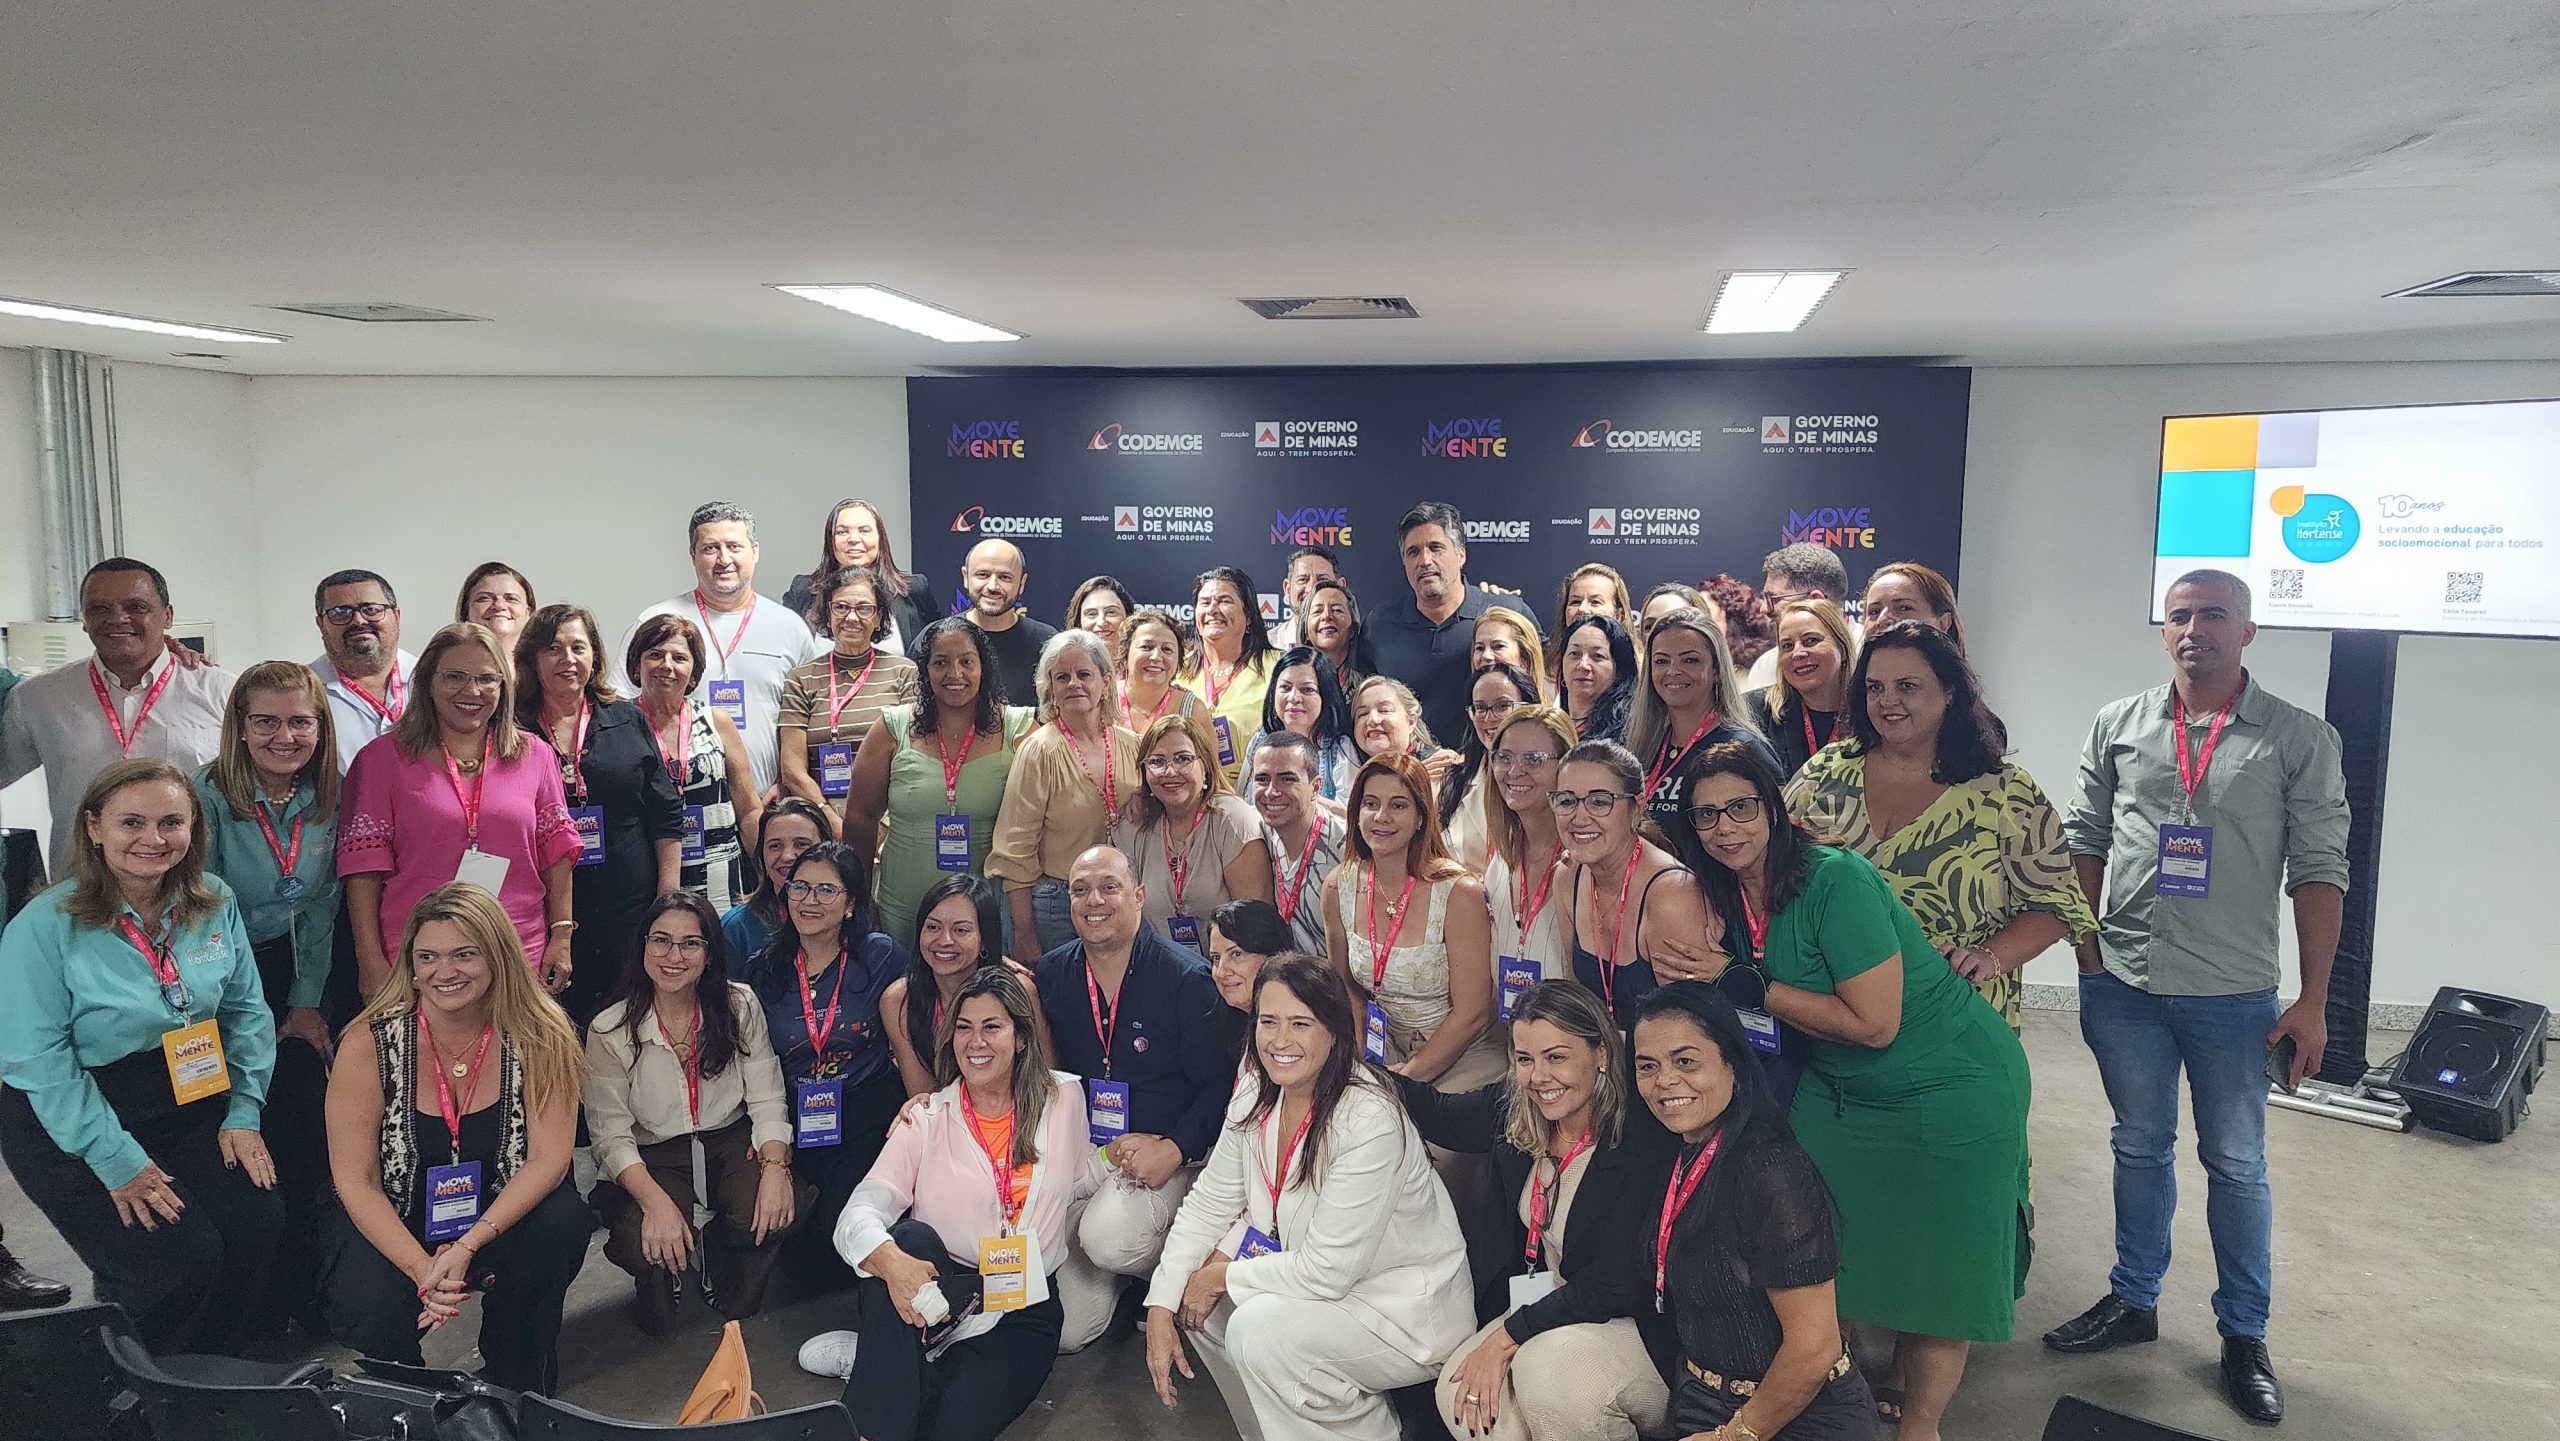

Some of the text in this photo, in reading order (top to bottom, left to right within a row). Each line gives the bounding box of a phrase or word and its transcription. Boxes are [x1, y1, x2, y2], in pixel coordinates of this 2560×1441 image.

[1284, 421, 1358, 433] GOVERNO
[1795, 415, 1879, 428] GOVERNO
[952, 420, 1020, 444] MOVE
[1428, 418, 1502, 444] MOVE
[1795, 430, 1878, 443] DE MINAS
[1118, 434, 1202, 450] CODEMGE
[1284, 435, 1358, 448] DE MINAS
[1606, 430, 1701, 448] CODEMGE
[947, 438, 1025, 459] MENTE
[1421, 436, 1507, 458] MENTE
[1142, 506, 1214, 518] GOVERNO
[2378, 495, 2445, 518] 10 anos
[1276, 507, 1348, 530] MOVE
[1620, 508, 1700, 521] GOVERNO
[1788, 507, 1871, 532] MOVE
[980, 516, 1062, 533] CODEMGE
[1143, 520, 1214, 532] DE MINAS
[1462, 521, 1530, 538] DEMGE
[1620, 523, 1700, 536] DE MINAS
[2379, 525, 2429, 534] Levando
[2443, 525, 2503, 536] educação
[1270, 524, 1352, 546] MENTE
[1781, 525, 1875, 549] MENTE
[2296, 528, 2343, 539] Hortense
[2378, 538, 2544, 549] socioemocional para todos
[825, 752, 847, 761] MOVE
[940, 829, 967, 838] MENTE
[942, 823, 965, 833] MOVE
[2168, 836, 2204, 847] MOVE
[2165, 843, 2205, 855] MENTE
[1506, 969, 1534, 979] MOVE
[175, 1033, 212, 1054] MOVE
[174, 1041, 215, 1060] MENTE
[806, 1092, 835, 1103] MOVE
[1096, 1090, 1122, 1102] MOVE
[803, 1098, 837, 1109] MENTE
[1093, 1097, 1124, 1109] MENTE
[437, 1175, 473, 1191] MOVE
[433, 1183, 475, 1198] MENTE
[989, 1247, 1020, 1260] MOVE
[986, 1256, 1022, 1267] MENTE
